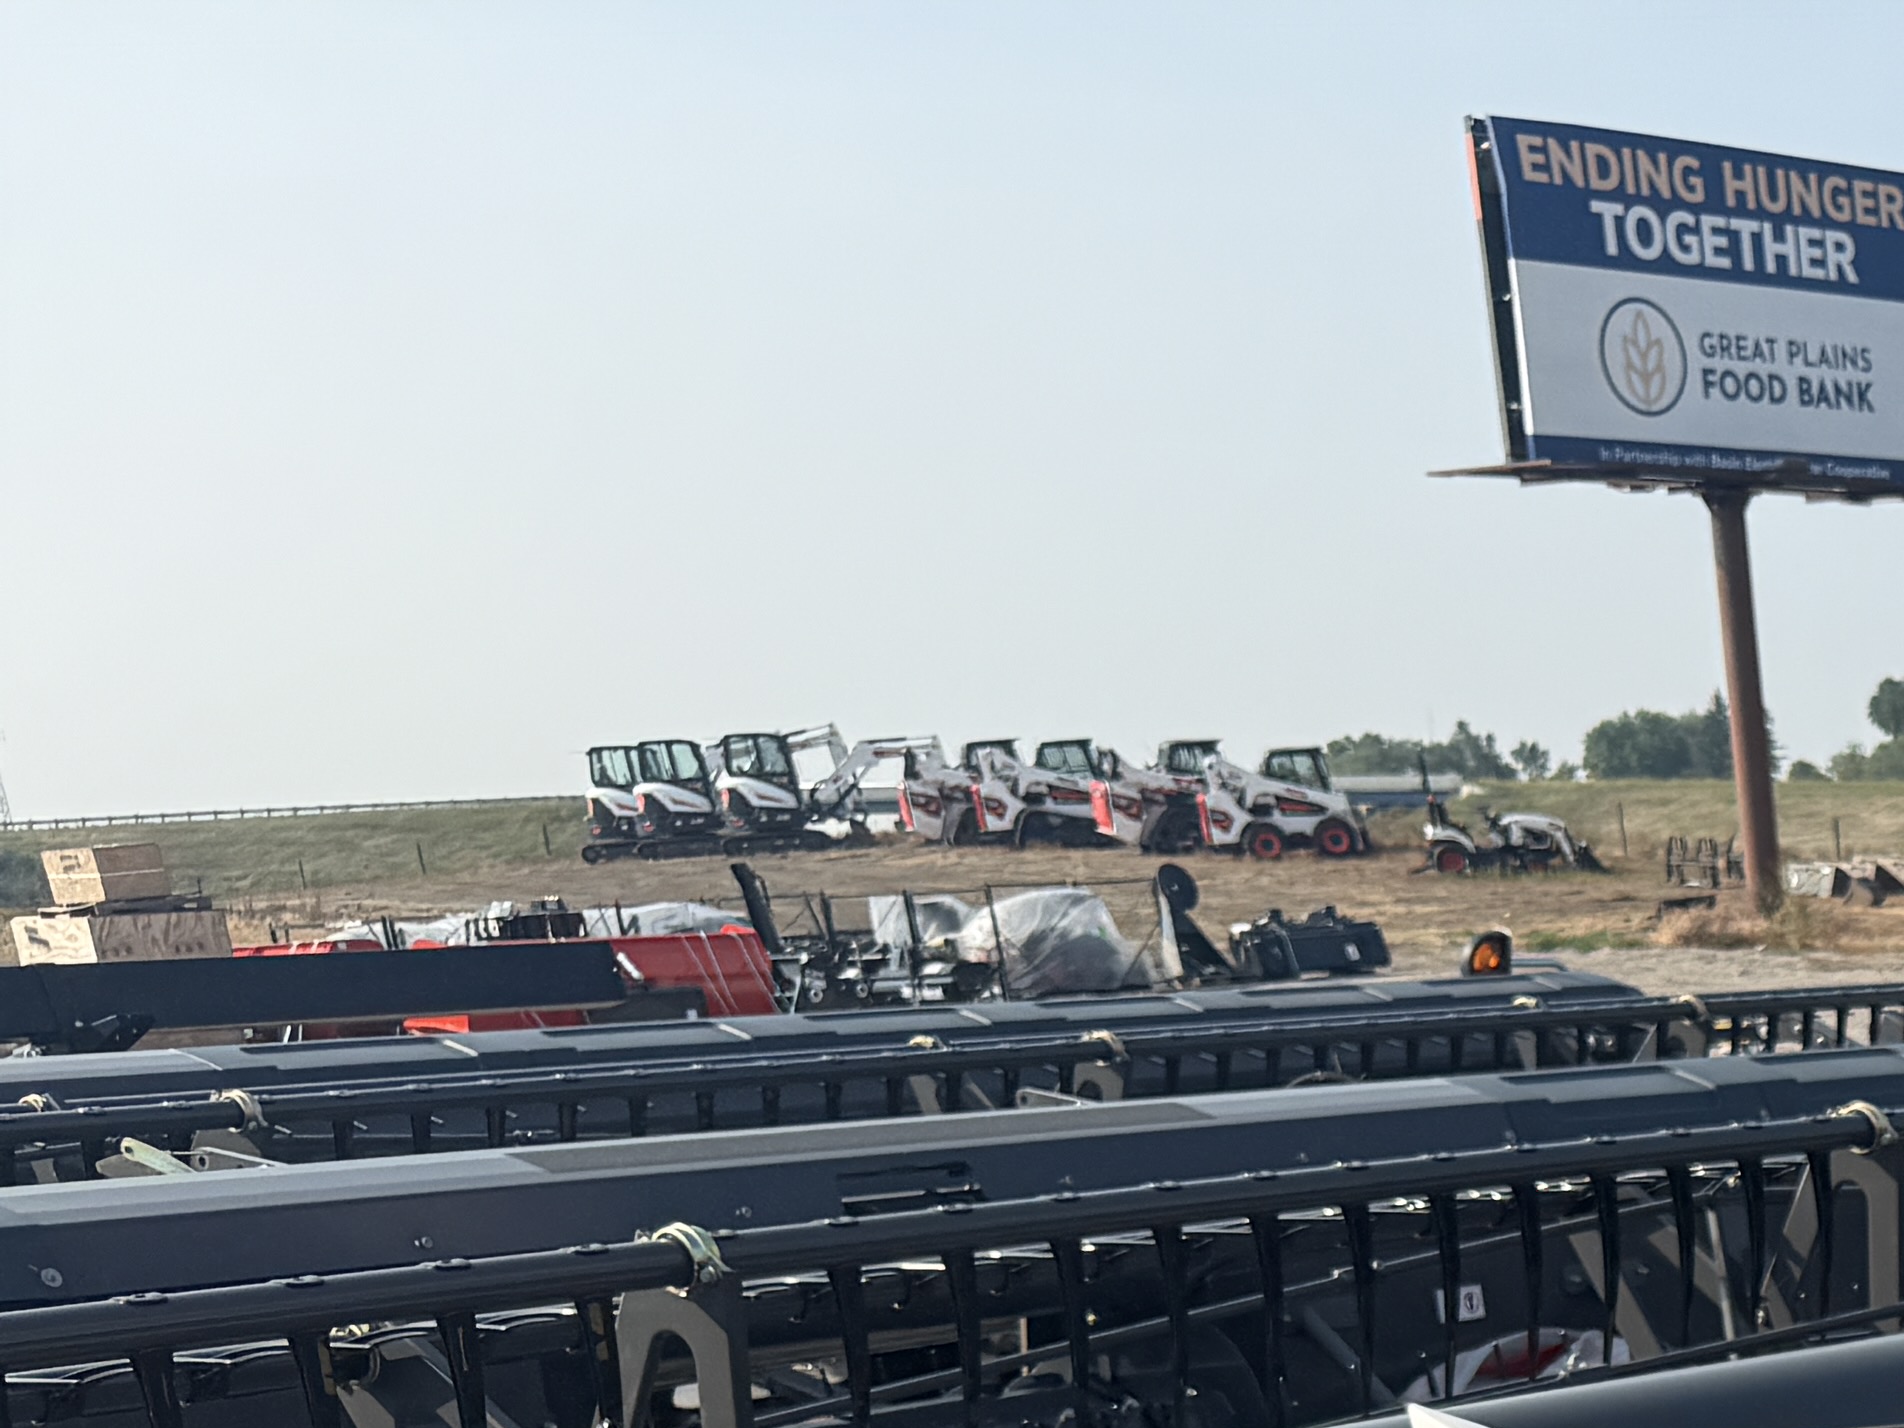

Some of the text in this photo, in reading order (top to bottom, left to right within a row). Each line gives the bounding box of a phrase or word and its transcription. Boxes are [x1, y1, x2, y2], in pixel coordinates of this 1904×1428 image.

[1515, 134, 1705, 203] ENDING
[1589, 200, 1859, 285] TOGETHER
[1700, 332, 1872, 373] GREAT PLAINS
[1702, 368, 1876, 414] FOOD BANK
